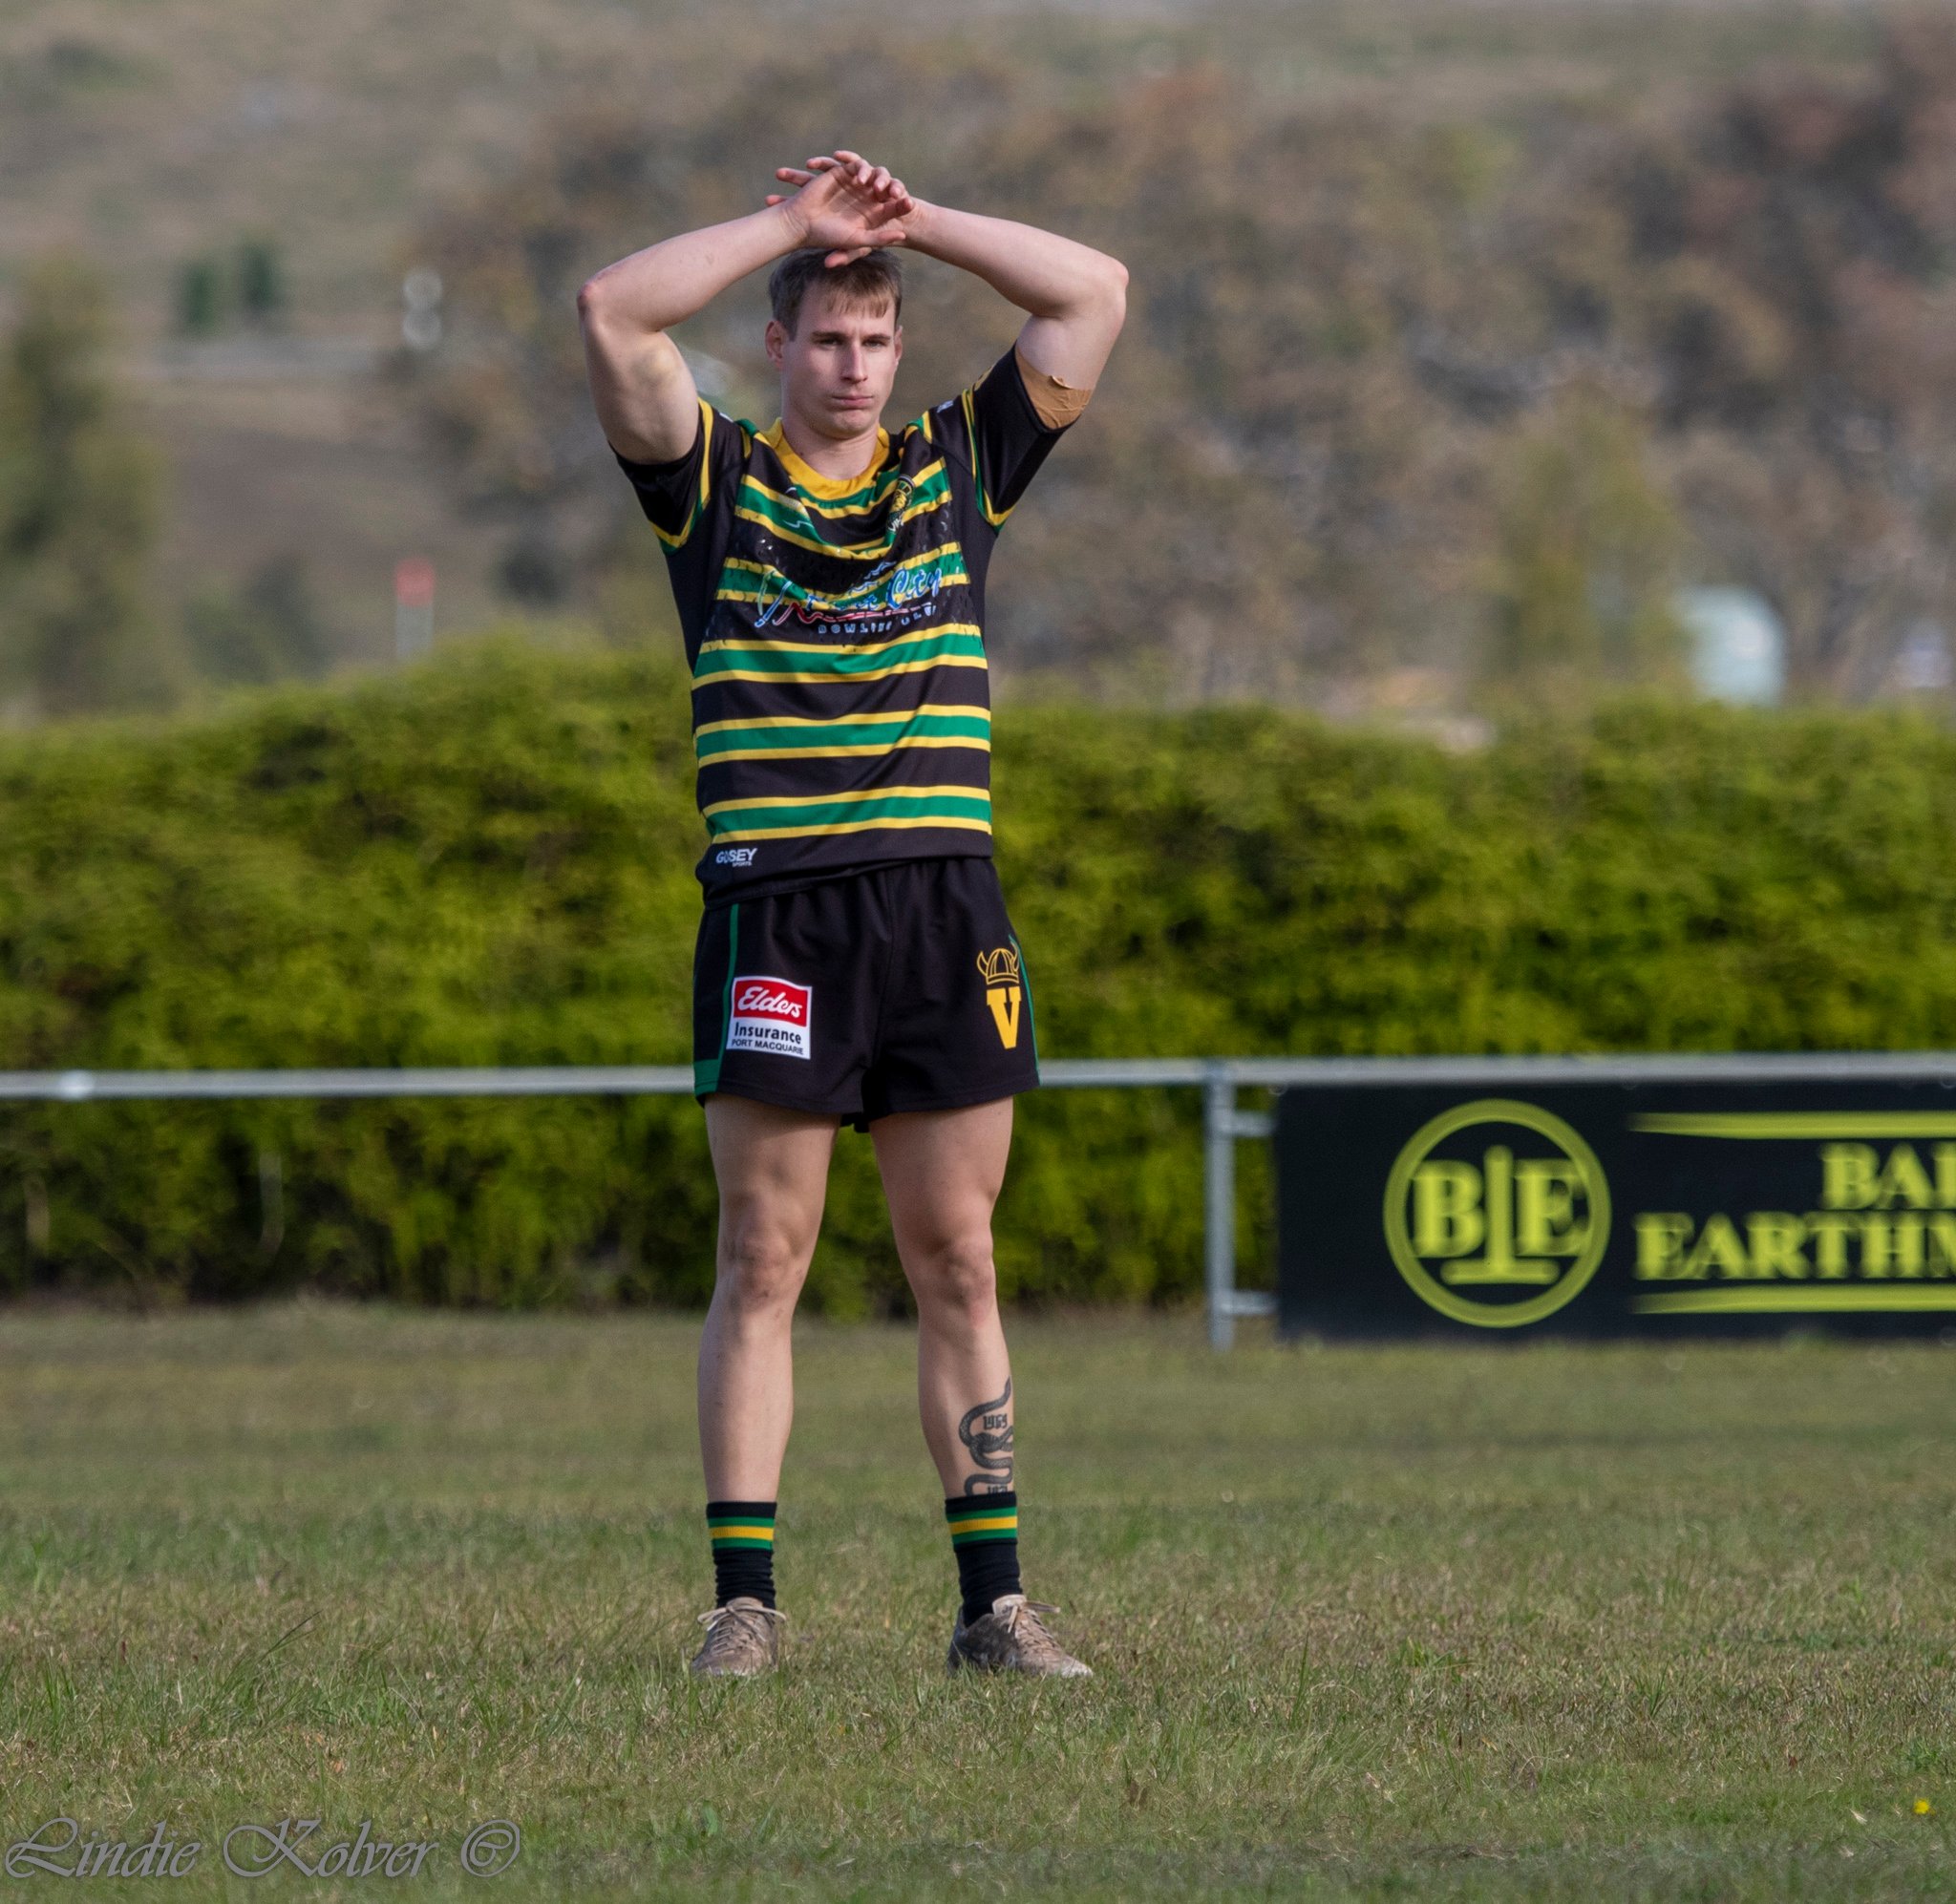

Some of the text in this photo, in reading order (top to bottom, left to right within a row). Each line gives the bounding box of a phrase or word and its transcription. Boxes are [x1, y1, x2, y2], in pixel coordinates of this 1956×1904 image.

[737, 986, 803, 1018] Elders
[734, 1021, 802, 1045] Insurance
[731, 1038, 804, 1055] PORT MACQUARIE
